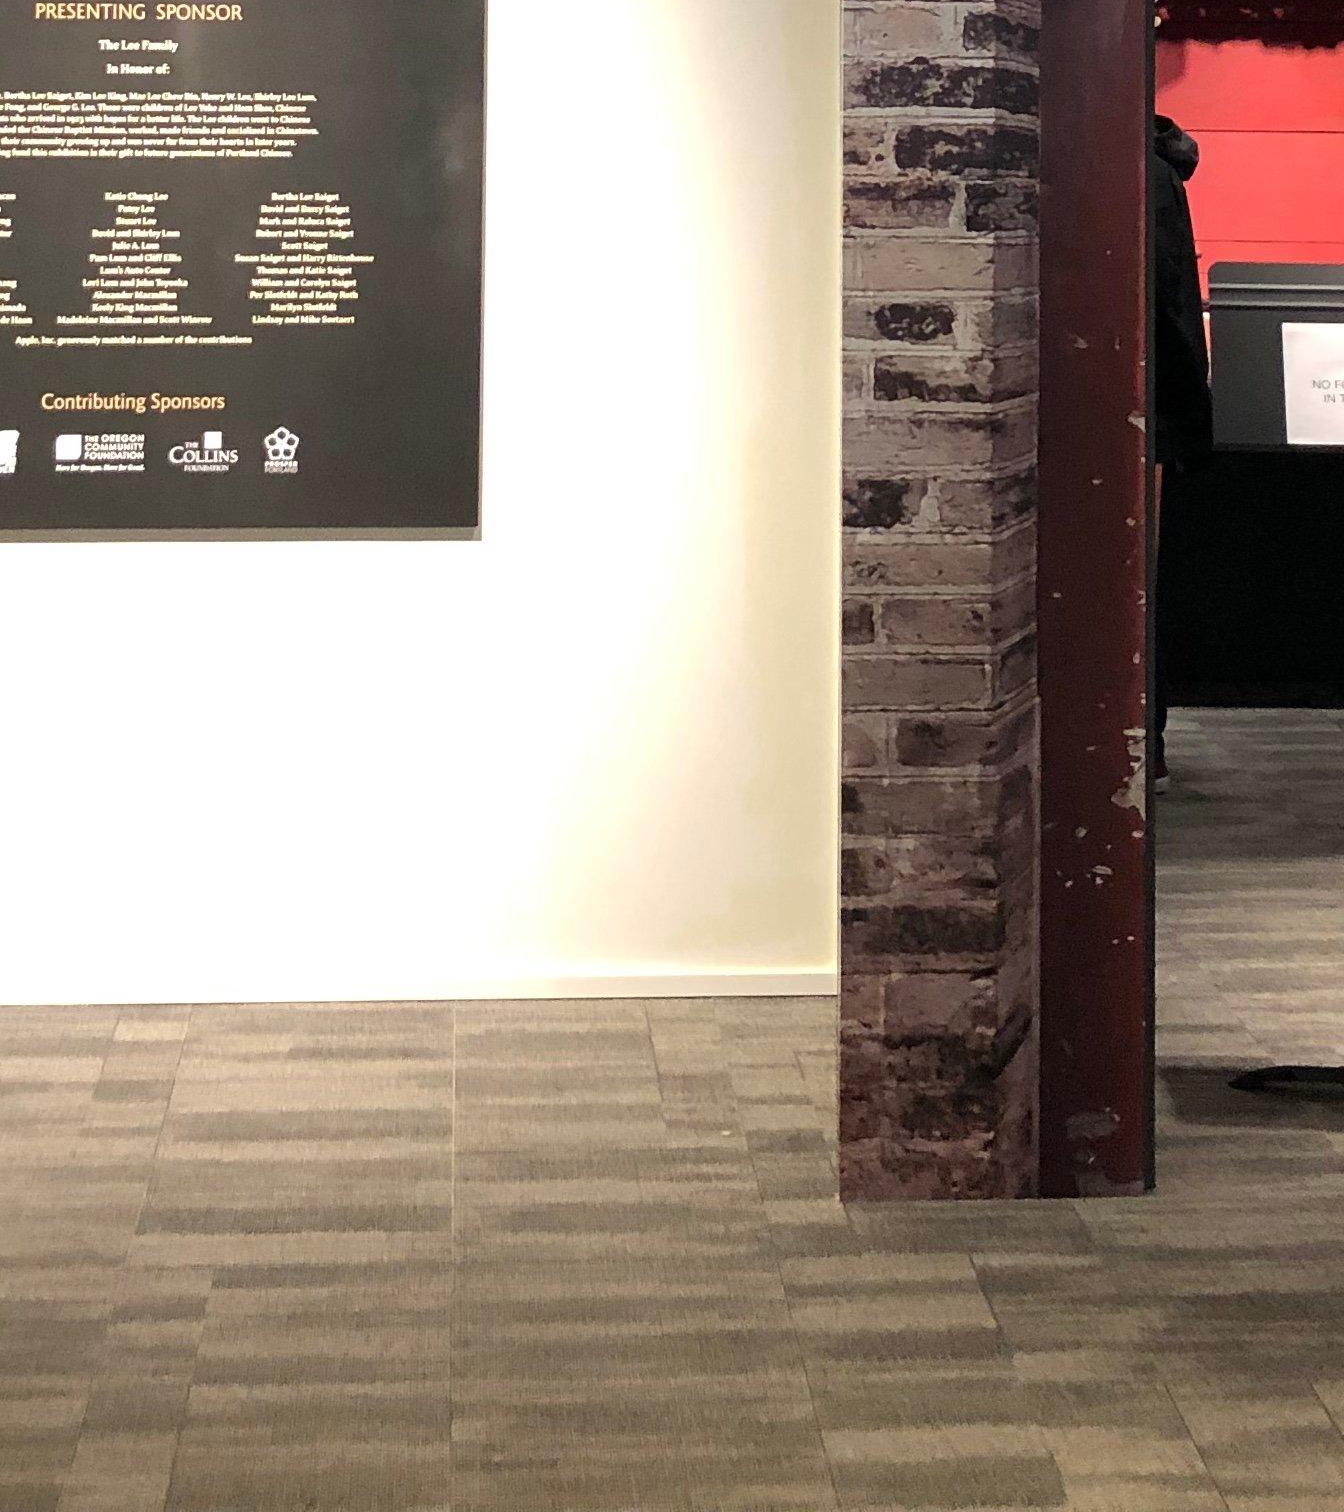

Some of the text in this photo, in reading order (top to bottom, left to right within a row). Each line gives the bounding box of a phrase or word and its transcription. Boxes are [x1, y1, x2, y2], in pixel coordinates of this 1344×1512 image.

[36, 3, 242, 20] PRESENTING SPONSOR
[1312, 380, 1331, 389] NO
[42, 393, 224, 413] Contributing Sponsors
[1324, 394, 1336, 402] IN
[84, 433, 144, 444] THE OREGON
[84, 442, 144, 452] COMMUNITY
[84, 450, 144, 460] FOUNDATION
[169, 445, 238, 463] COLLINS
[184, 464, 228, 472] FOUNDATION
